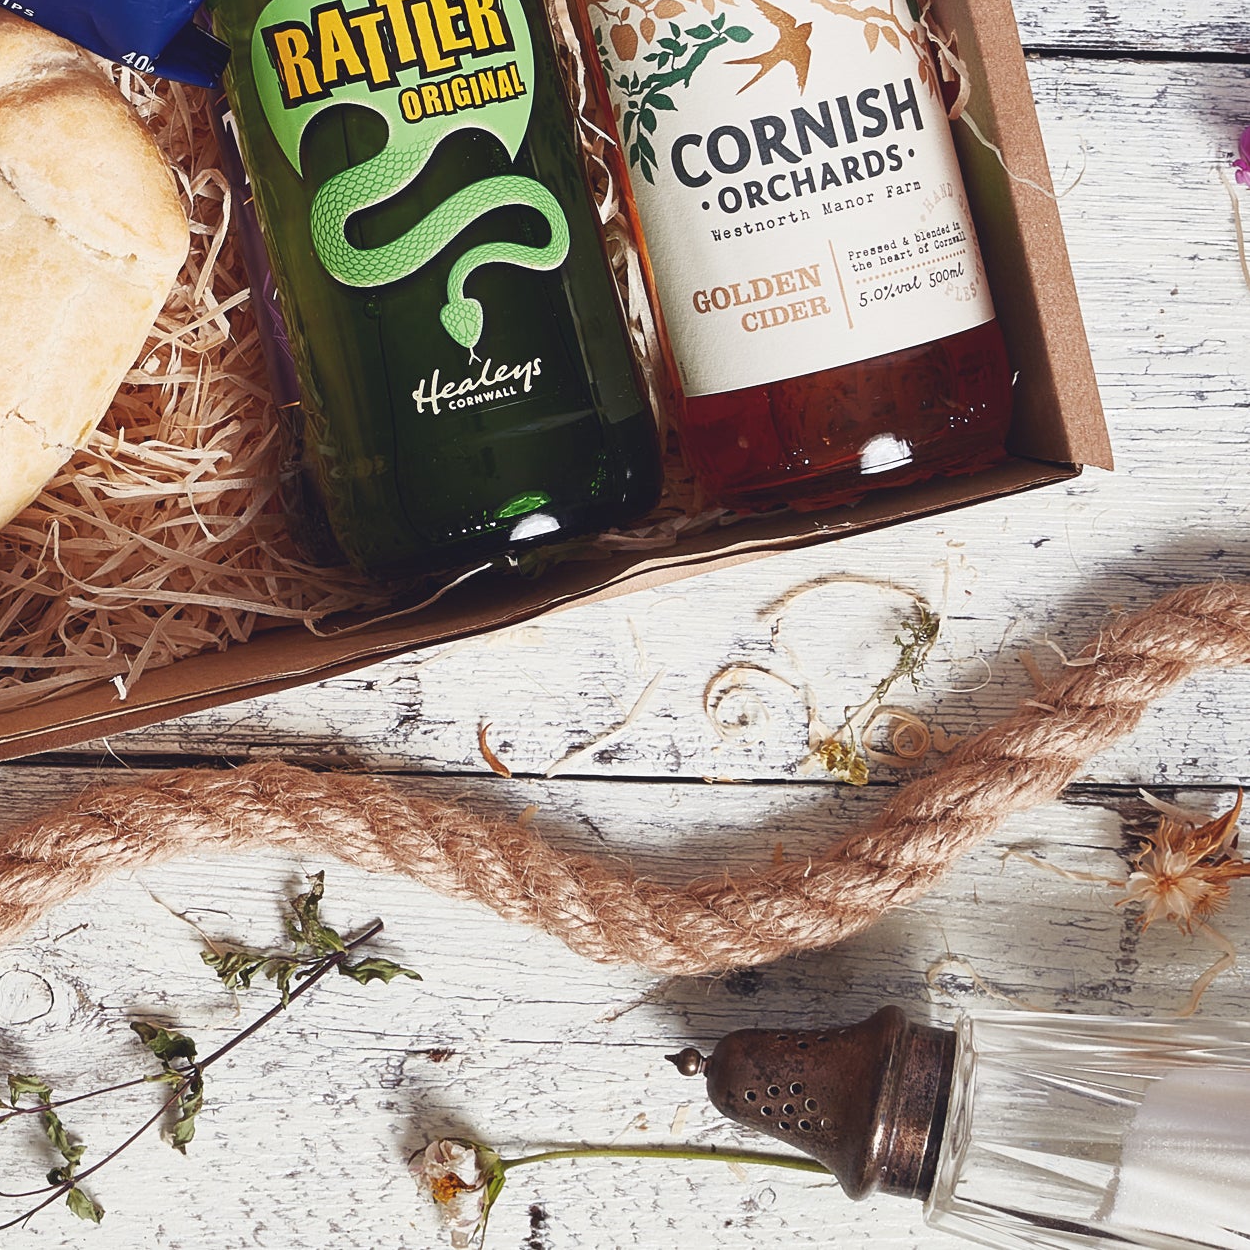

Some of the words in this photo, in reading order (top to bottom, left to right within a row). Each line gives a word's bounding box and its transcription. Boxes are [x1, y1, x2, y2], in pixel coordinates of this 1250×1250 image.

[401, 66, 525, 121] ORIGINAL
[670, 77, 925, 190] CORNISH
[711, 209, 811, 242] Westnorth
[822, 191, 875, 215] Manor
[886, 180, 922, 200] Farm
[848, 239, 897, 261] Pressed
[902, 236, 910, 247] &
[914, 223, 950, 243] blended
[953, 221, 961, 230] in
[851, 261, 873, 272] the
[879, 250, 913, 265] heart
[918, 243, 929, 255] of
[934, 231, 966, 250] Cornwall
[692, 263, 822, 315] GOLDEN
[929, 262, 964, 288] 500ml
[741, 296, 831, 333] CIDER
[412, 355, 542, 416] Healeys
[448, 385, 518, 411] CORNWALL
